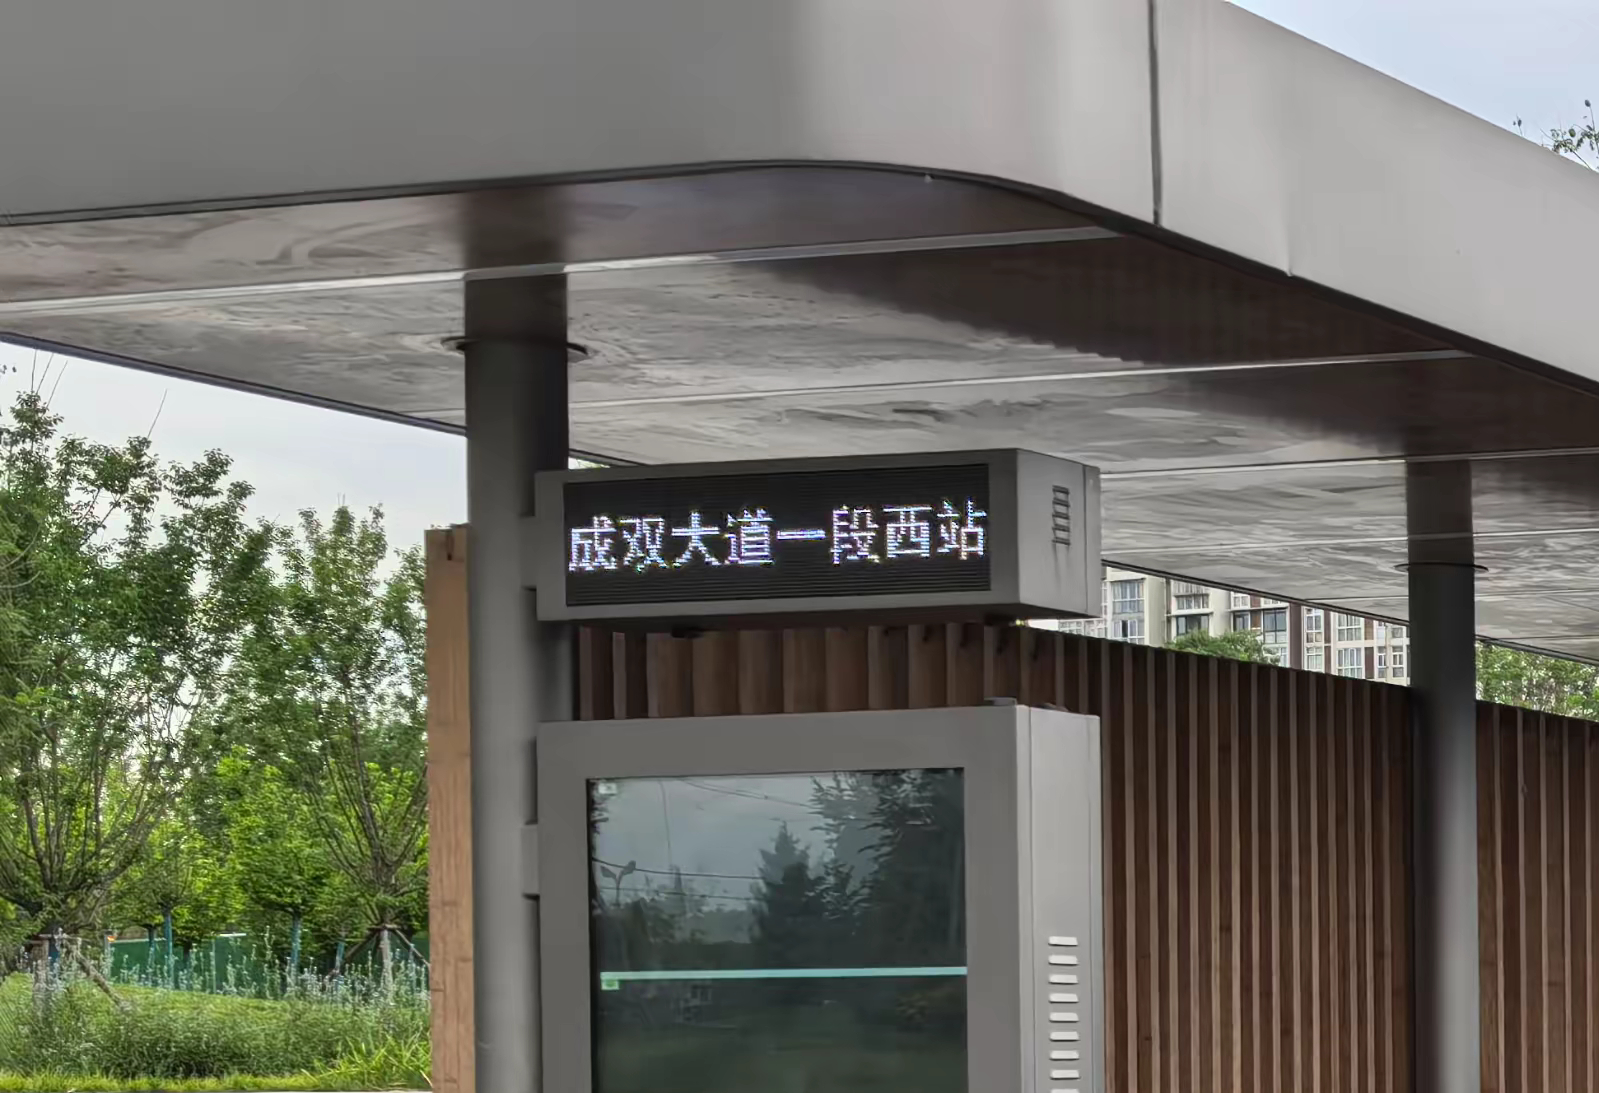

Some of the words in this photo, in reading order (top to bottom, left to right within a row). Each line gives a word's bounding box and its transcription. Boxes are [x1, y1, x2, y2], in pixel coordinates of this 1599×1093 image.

[567, 498, 988, 574] 成双大道一段西站
